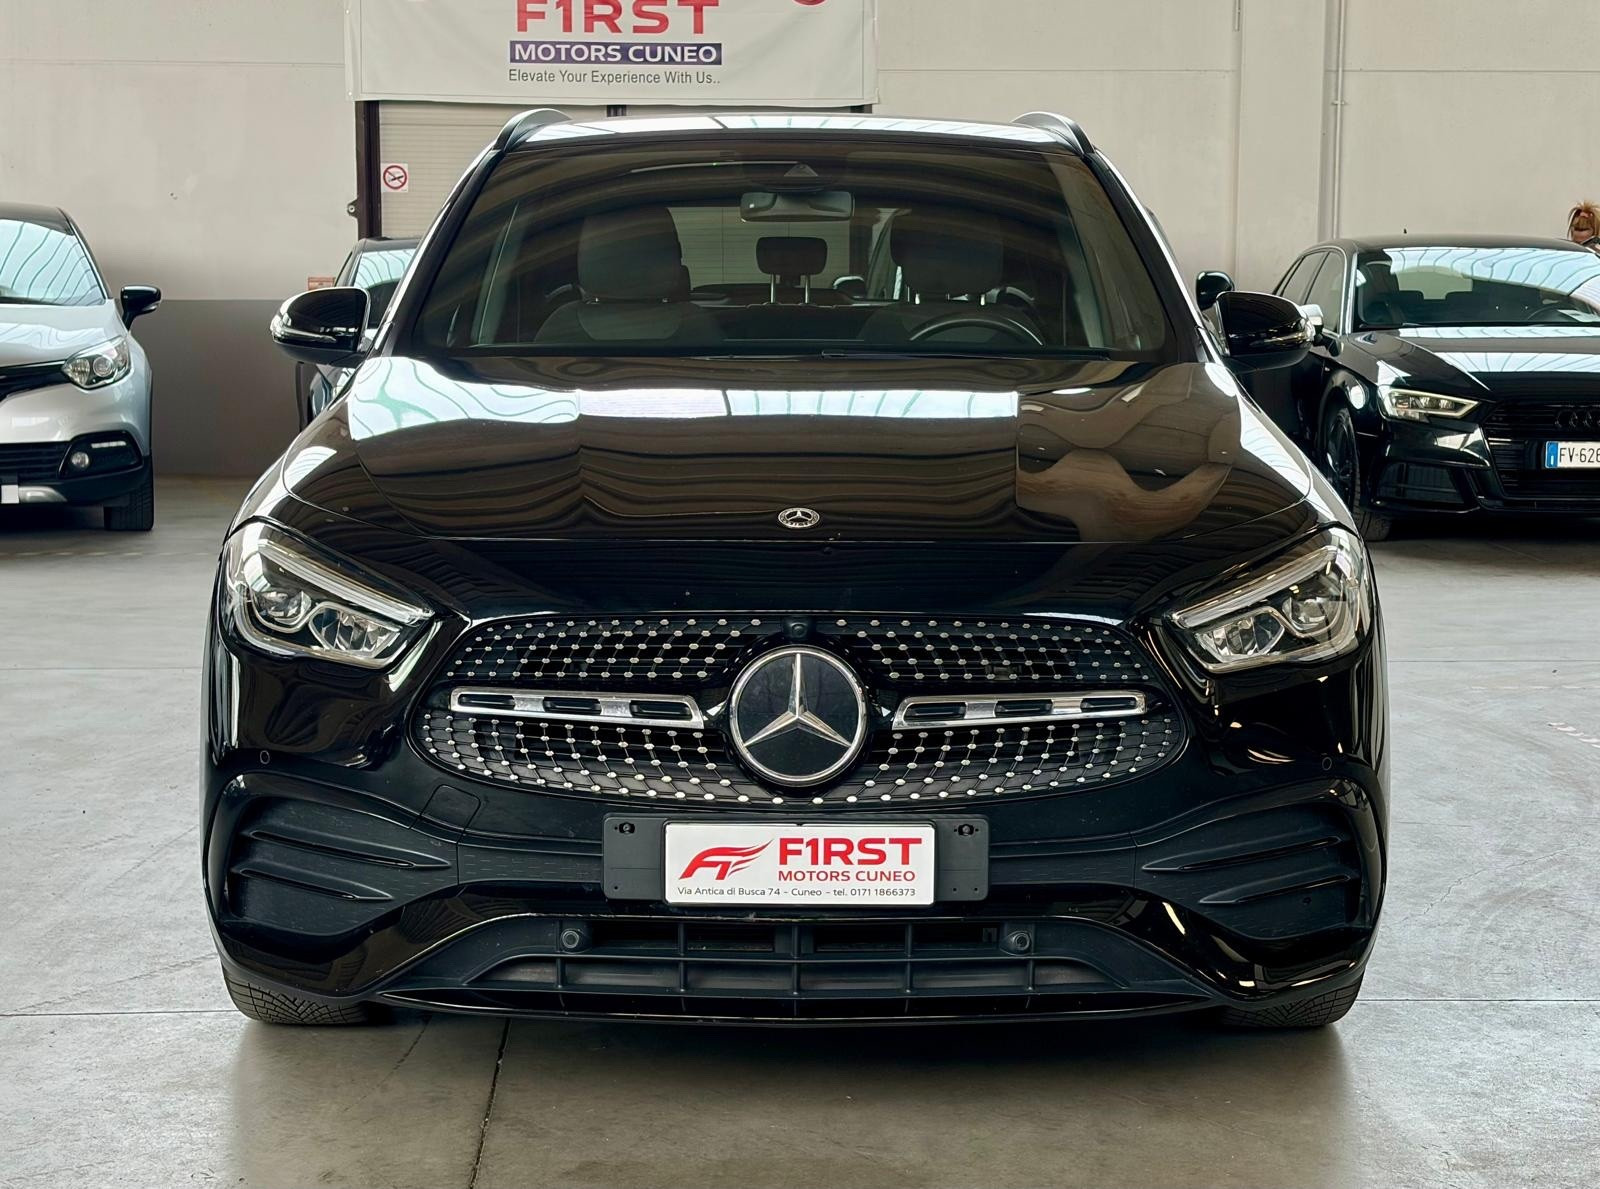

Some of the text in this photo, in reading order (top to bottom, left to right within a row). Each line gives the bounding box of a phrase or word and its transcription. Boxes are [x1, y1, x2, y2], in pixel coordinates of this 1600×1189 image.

[516, 0, 719, 34] F1RST
[515, 44, 717, 63] MOTORS CUNEO
[509, 68, 721, 85] Elevate Your Experience With Us..
[779, 837, 923, 866] F1RST
[778, 870, 916, 882] MOTORS CUNEO
[677, 887, 692, 896] Via
[695, 887, 724, 896] Antica
[727, 887, 736, 896] di
[738, 887, 766, 896] Busca
[768, 888, 781, 896] 74
[791, 888, 822, 897] Cuneo
[833, 888, 848, 897] tel.
[850, 888, 871, 897] 0171
[875, 888, 916, 897] 1866373
